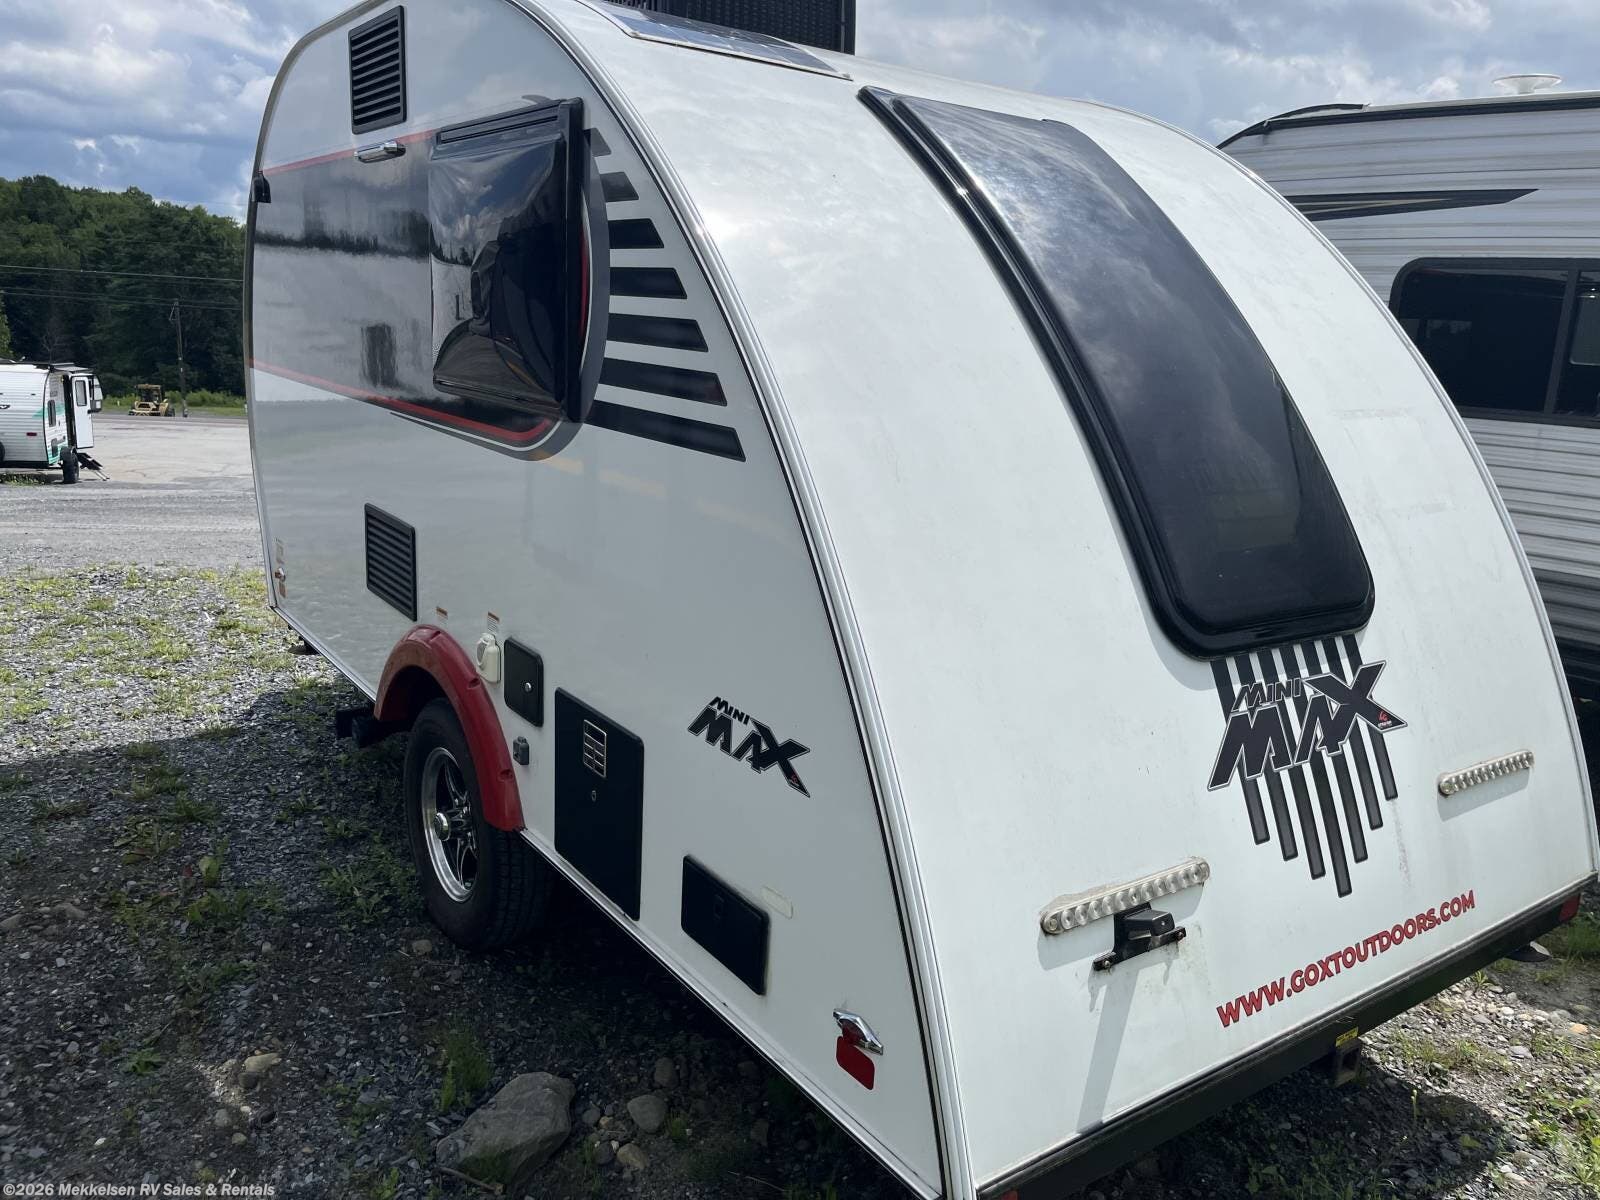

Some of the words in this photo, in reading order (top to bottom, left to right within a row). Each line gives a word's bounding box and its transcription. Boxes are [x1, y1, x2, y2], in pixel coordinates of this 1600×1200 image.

[708, 696, 750, 726] MINI
[1207, 659, 1408, 792] MAX
[1230, 678, 1302, 713] MINI
[687, 704, 811, 798] MAX
[1216, 889, 1476, 1028] WWW.GOXTOUTDOORS.COM
